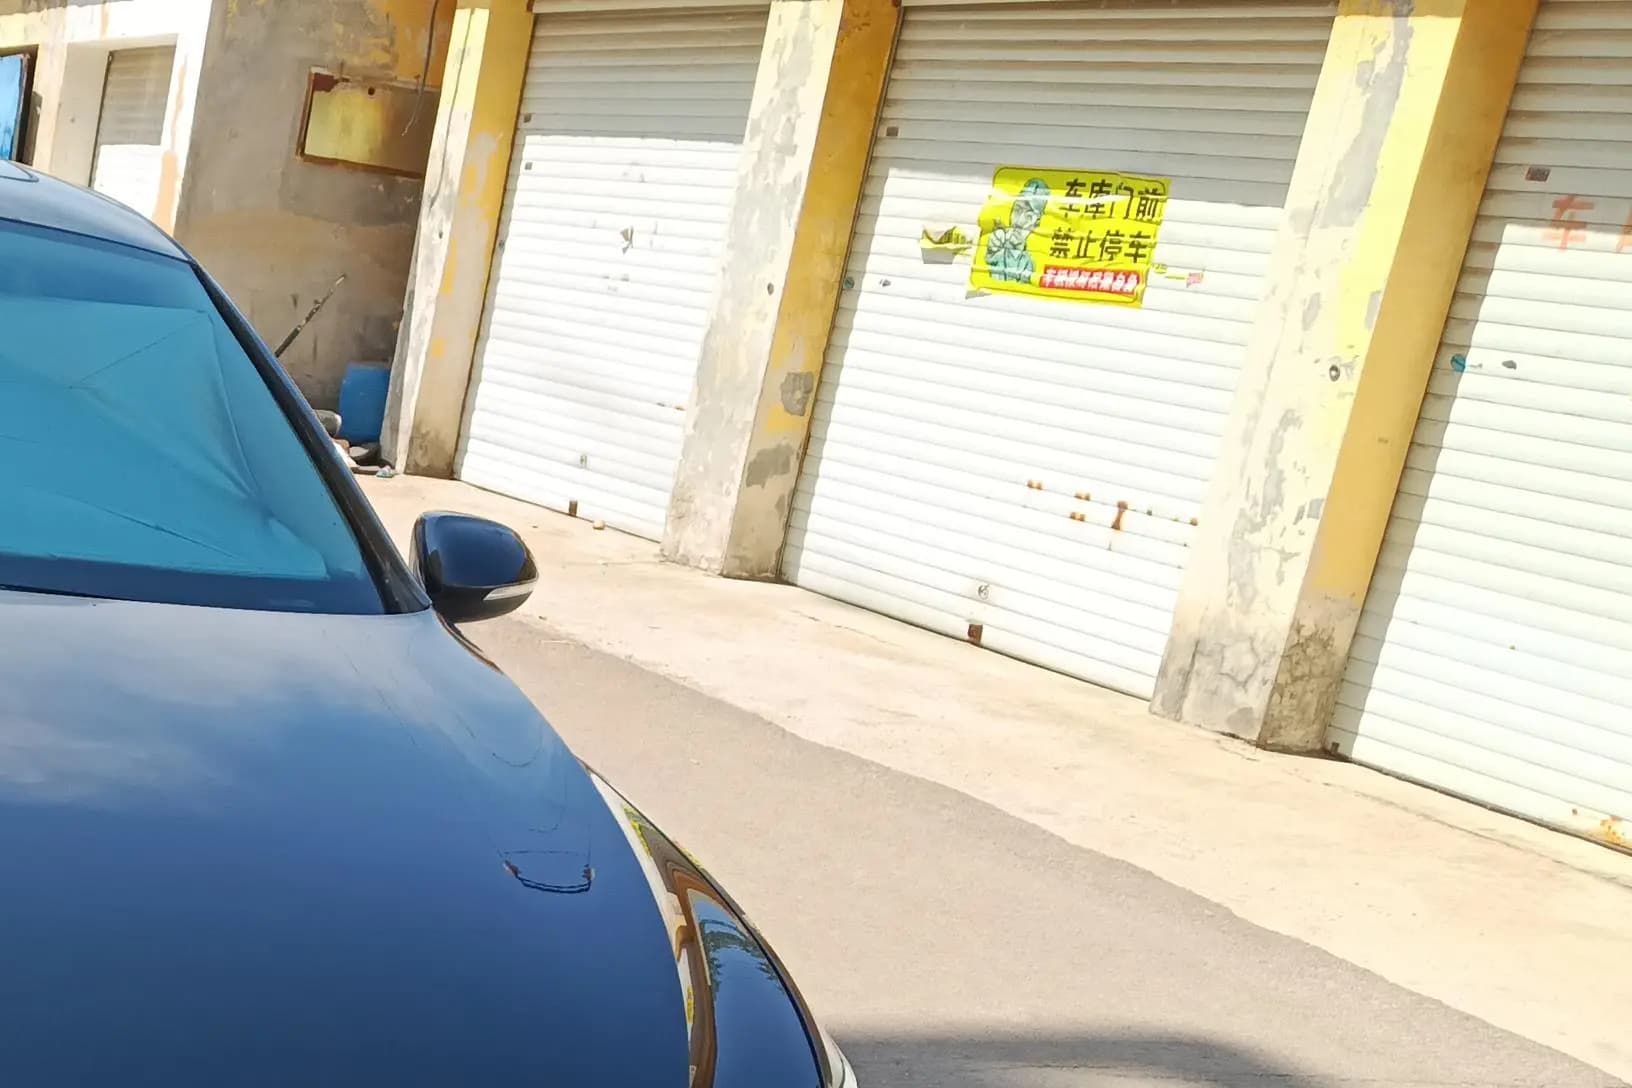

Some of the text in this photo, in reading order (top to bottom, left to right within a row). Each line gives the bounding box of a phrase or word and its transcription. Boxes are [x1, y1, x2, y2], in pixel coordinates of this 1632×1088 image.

[1059, 178, 1163, 220] 车库门前
[1049, 227, 1151, 263] 禁止停车
